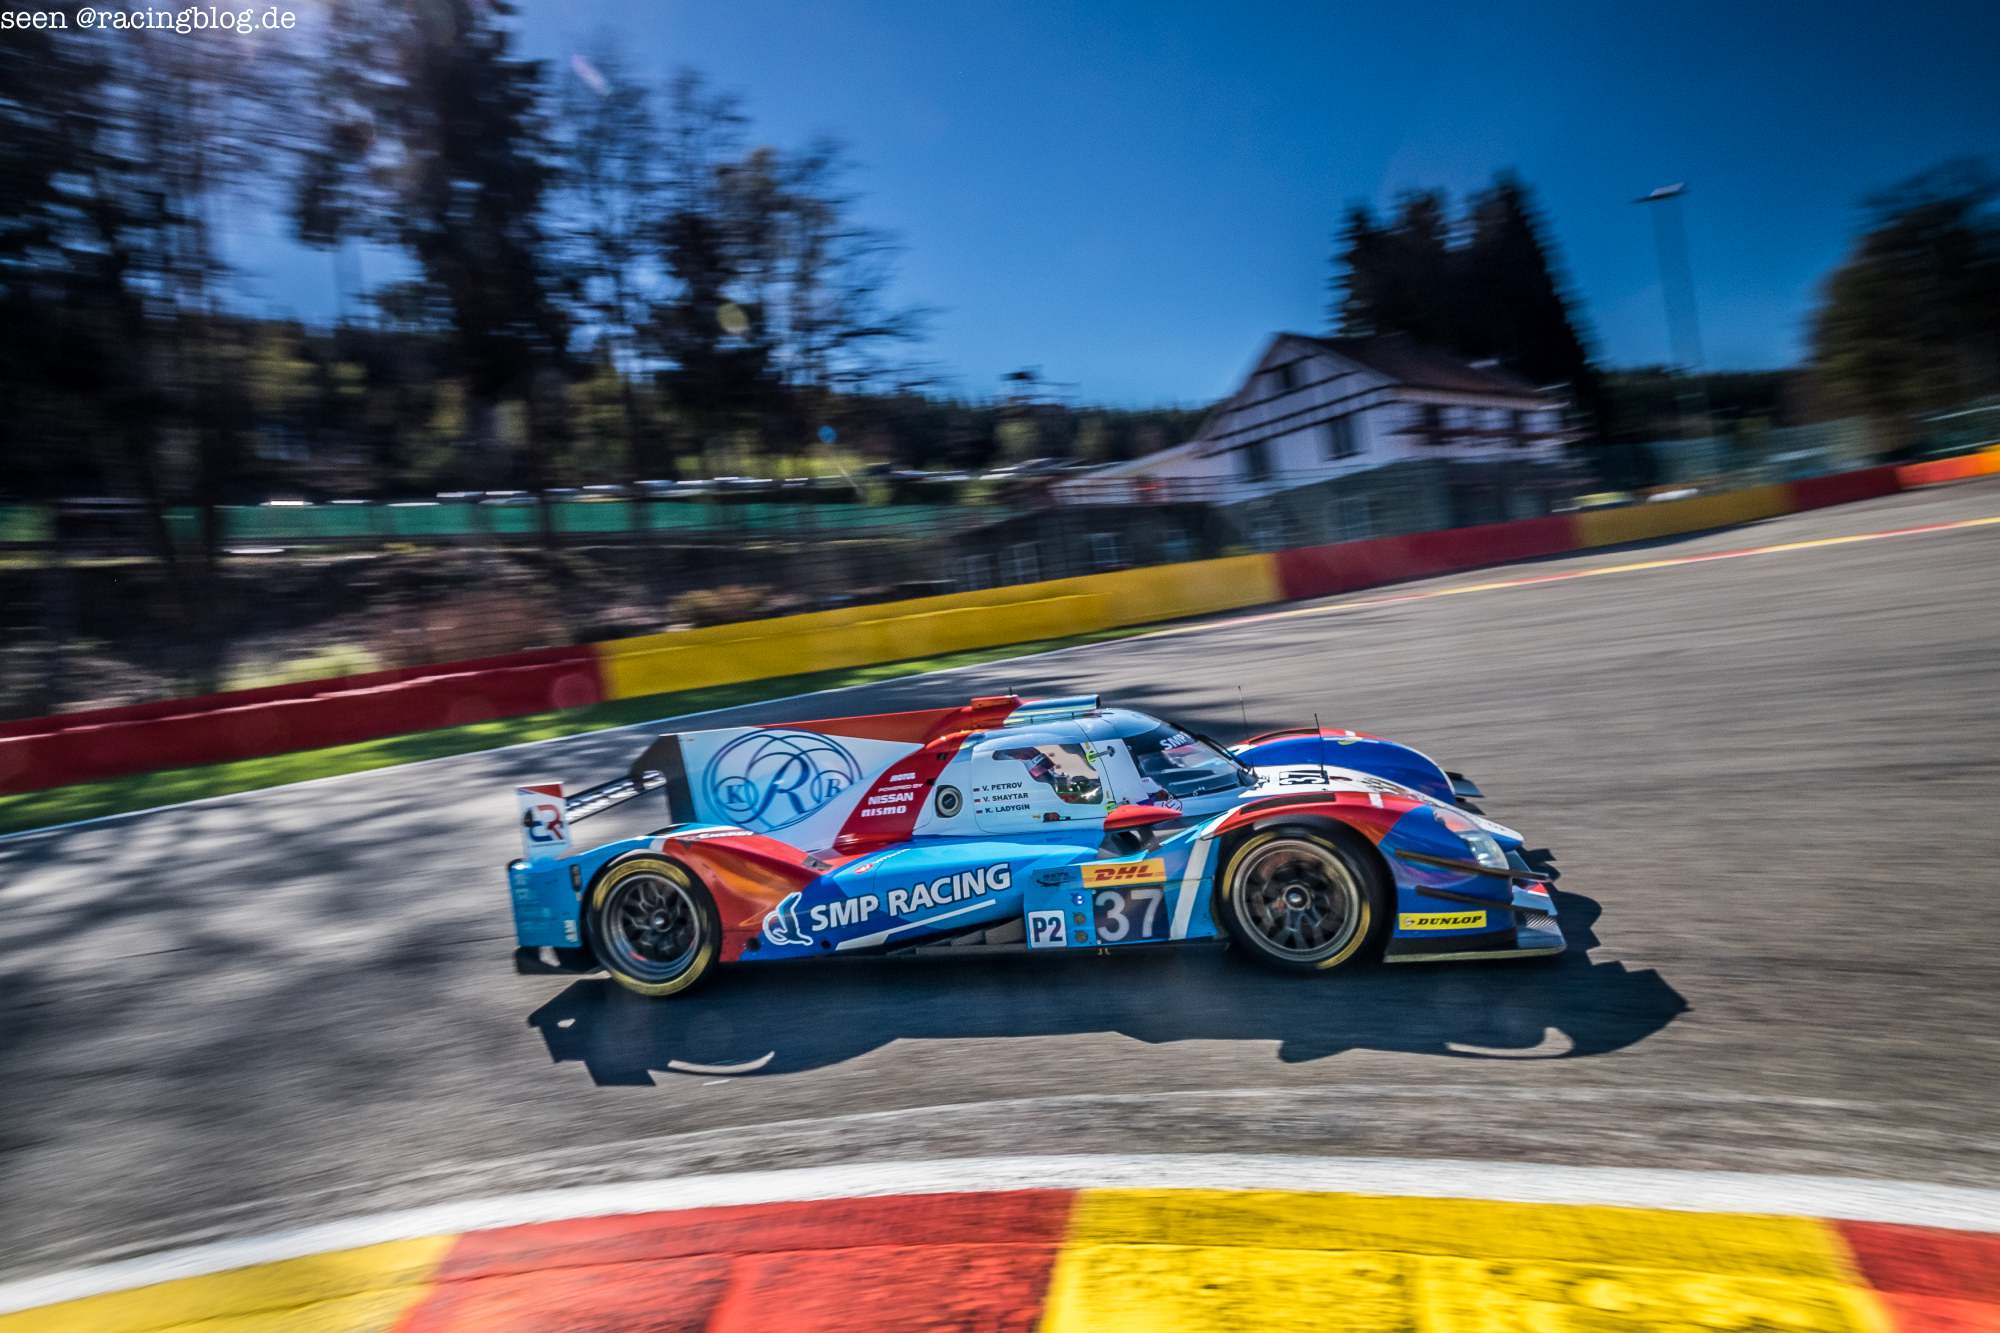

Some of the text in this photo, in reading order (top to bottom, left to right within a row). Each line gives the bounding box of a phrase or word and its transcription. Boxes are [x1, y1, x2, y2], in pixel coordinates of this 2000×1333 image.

[725, 783, 747, 805] K
[991, 782, 1023, 792] PETROV
[868, 792, 914, 805] NISSAN
[992, 792, 1029, 803] SHAYTAR
[995, 804, 1031, 814] LADYGIN
[1094, 865, 1153, 881] DHL
[810, 863, 1012, 932] SMP RACING
[1095, 888, 1164, 942] 37
[1417, 915, 1482, 926] DUNLOP
[1031, 916, 1064, 942] P2
